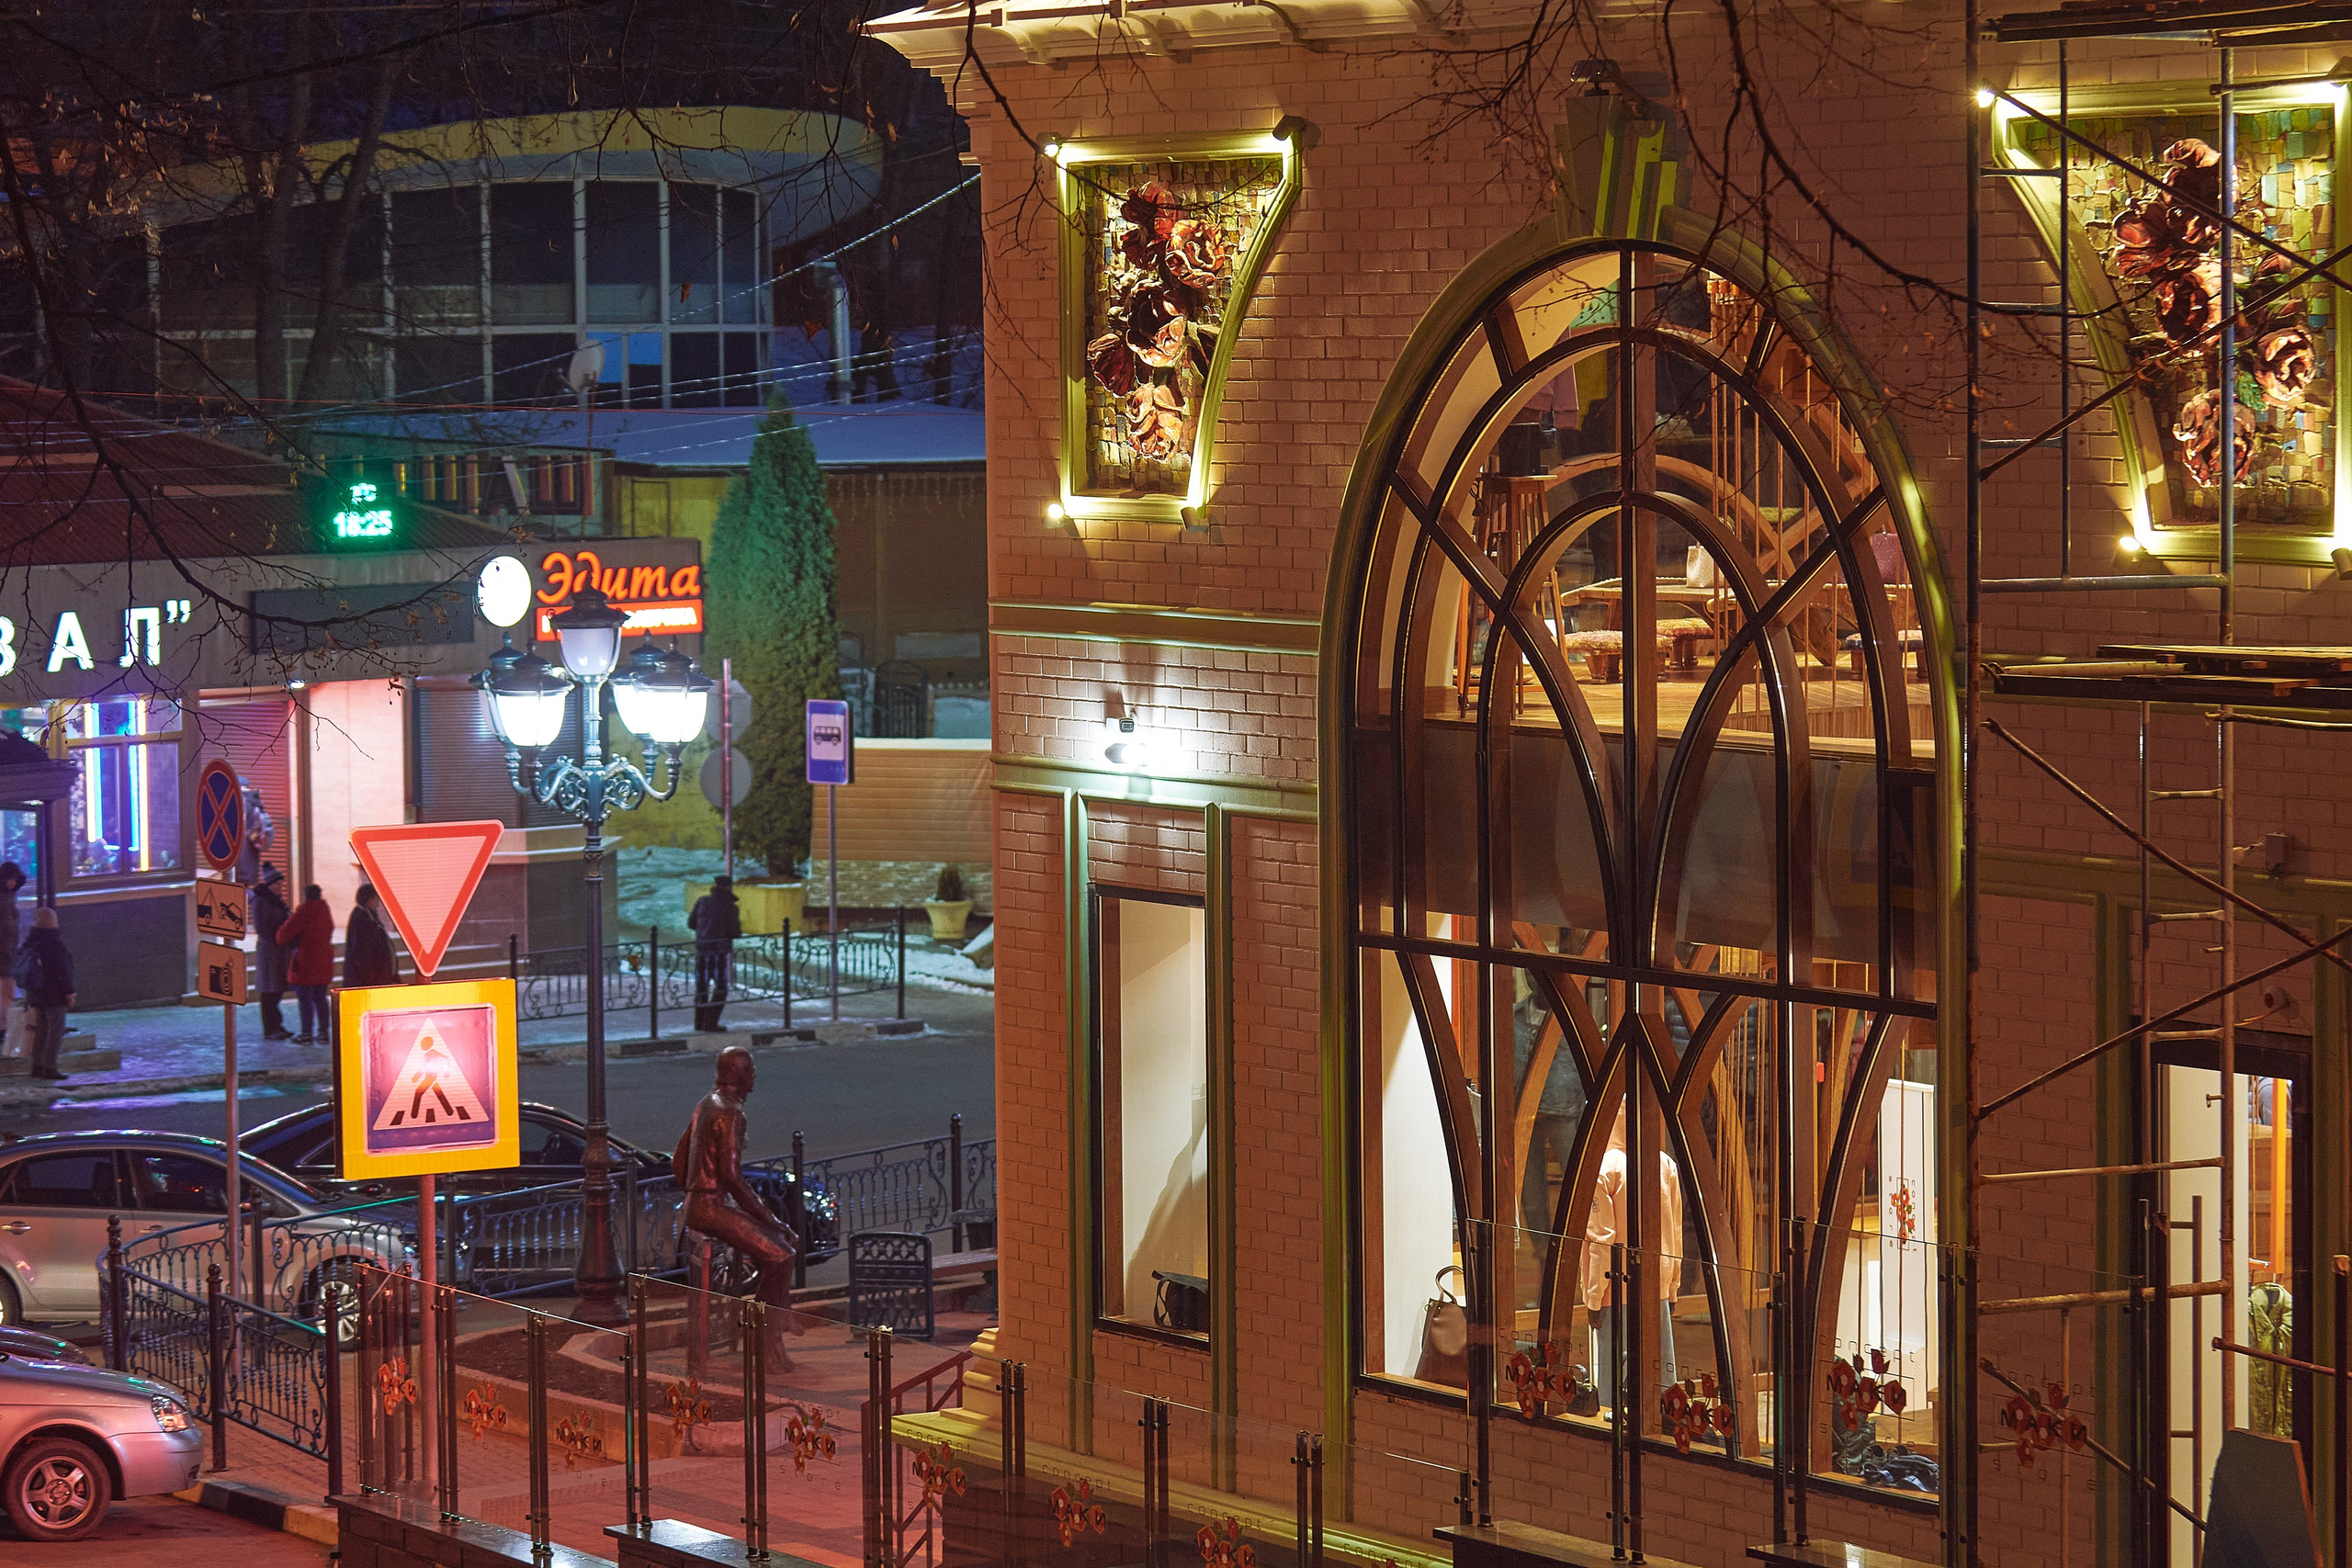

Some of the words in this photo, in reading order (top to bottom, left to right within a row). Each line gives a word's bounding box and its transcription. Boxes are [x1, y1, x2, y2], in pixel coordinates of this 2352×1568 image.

[537, 551, 701, 604] Эдита
[1506, 1365, 1576, 1395] МАКИ
[557, 1427, 602, 1452] МАКИ
[2001, 1408, 2086, 1442] МАКИ
[785, 1427, 836, 1455] МАКИ
[912, 1461, 966, 1489] МАКИ
